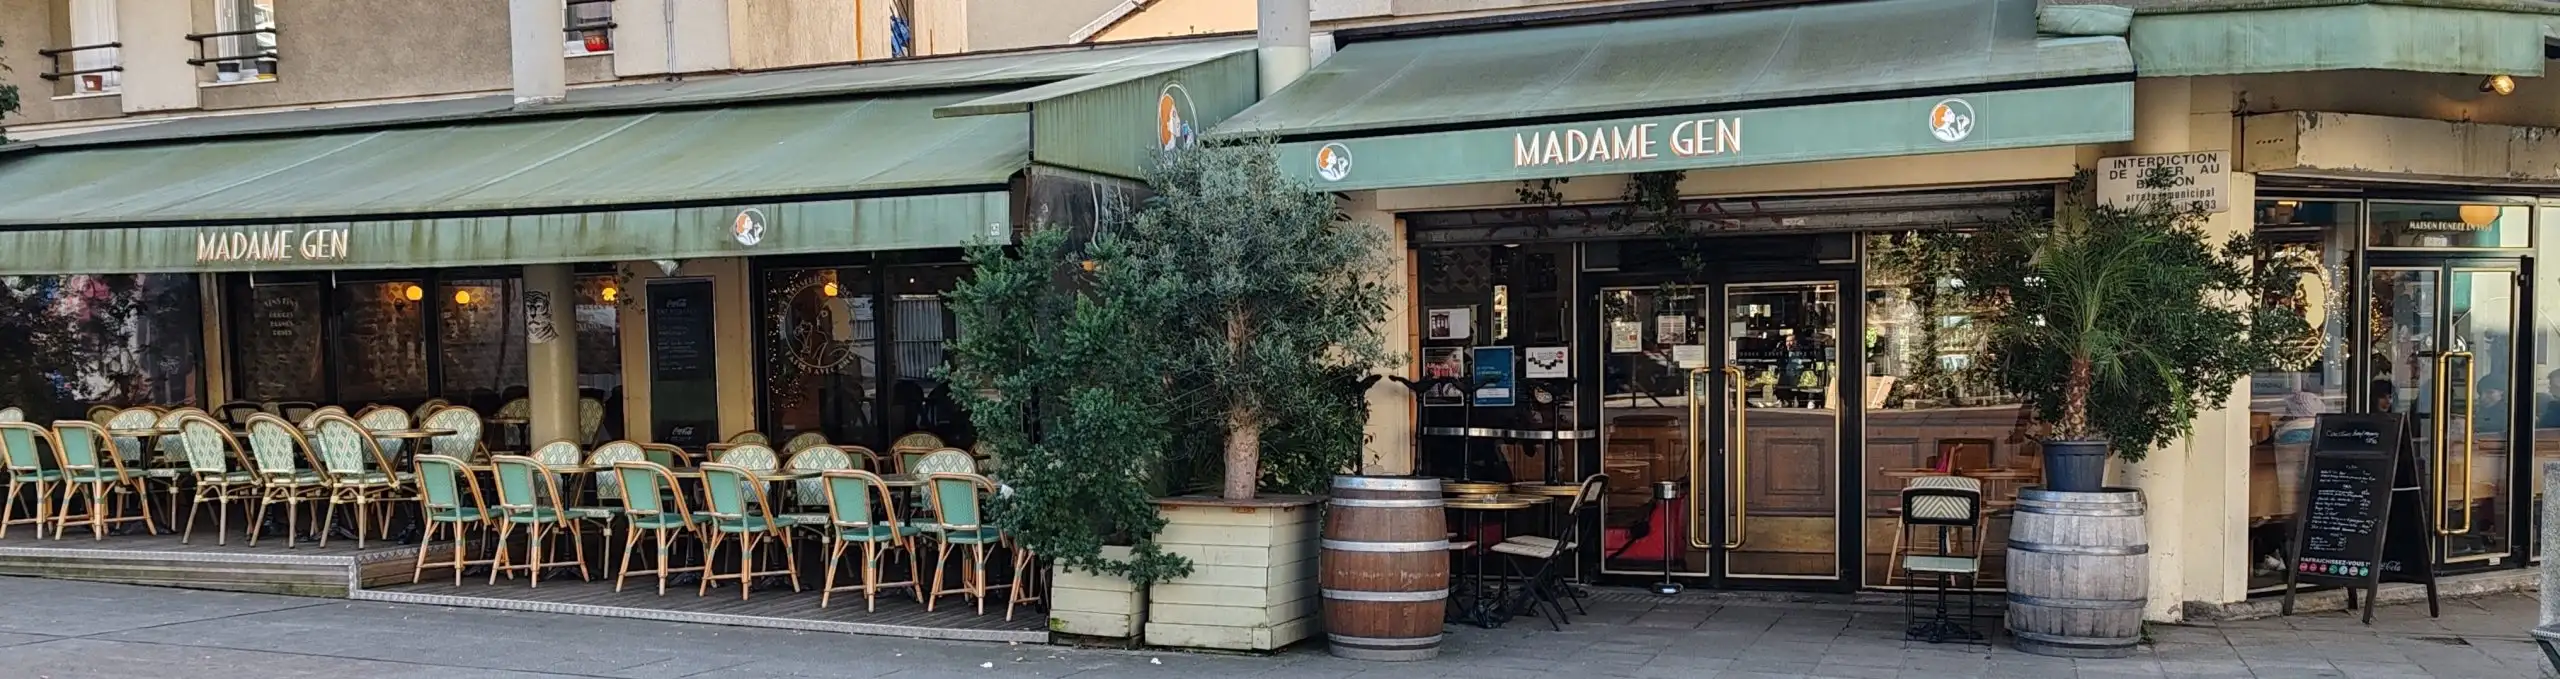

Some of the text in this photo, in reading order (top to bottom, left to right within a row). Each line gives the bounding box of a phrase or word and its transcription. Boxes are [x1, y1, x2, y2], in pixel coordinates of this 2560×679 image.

[1515, 117, 1741, 167] MADAME GEN
[2113, 153, 2218, 169] INTERDICTION
[2109, 164, 2220, 180] DE JOER AU
[2136, 176, 2195, 189] BON
[2168, 187, 2215, 200] municipal
[2409, 220, 2437, 230] MAISON
[196, 228, 349, 262] MADAME GEN
